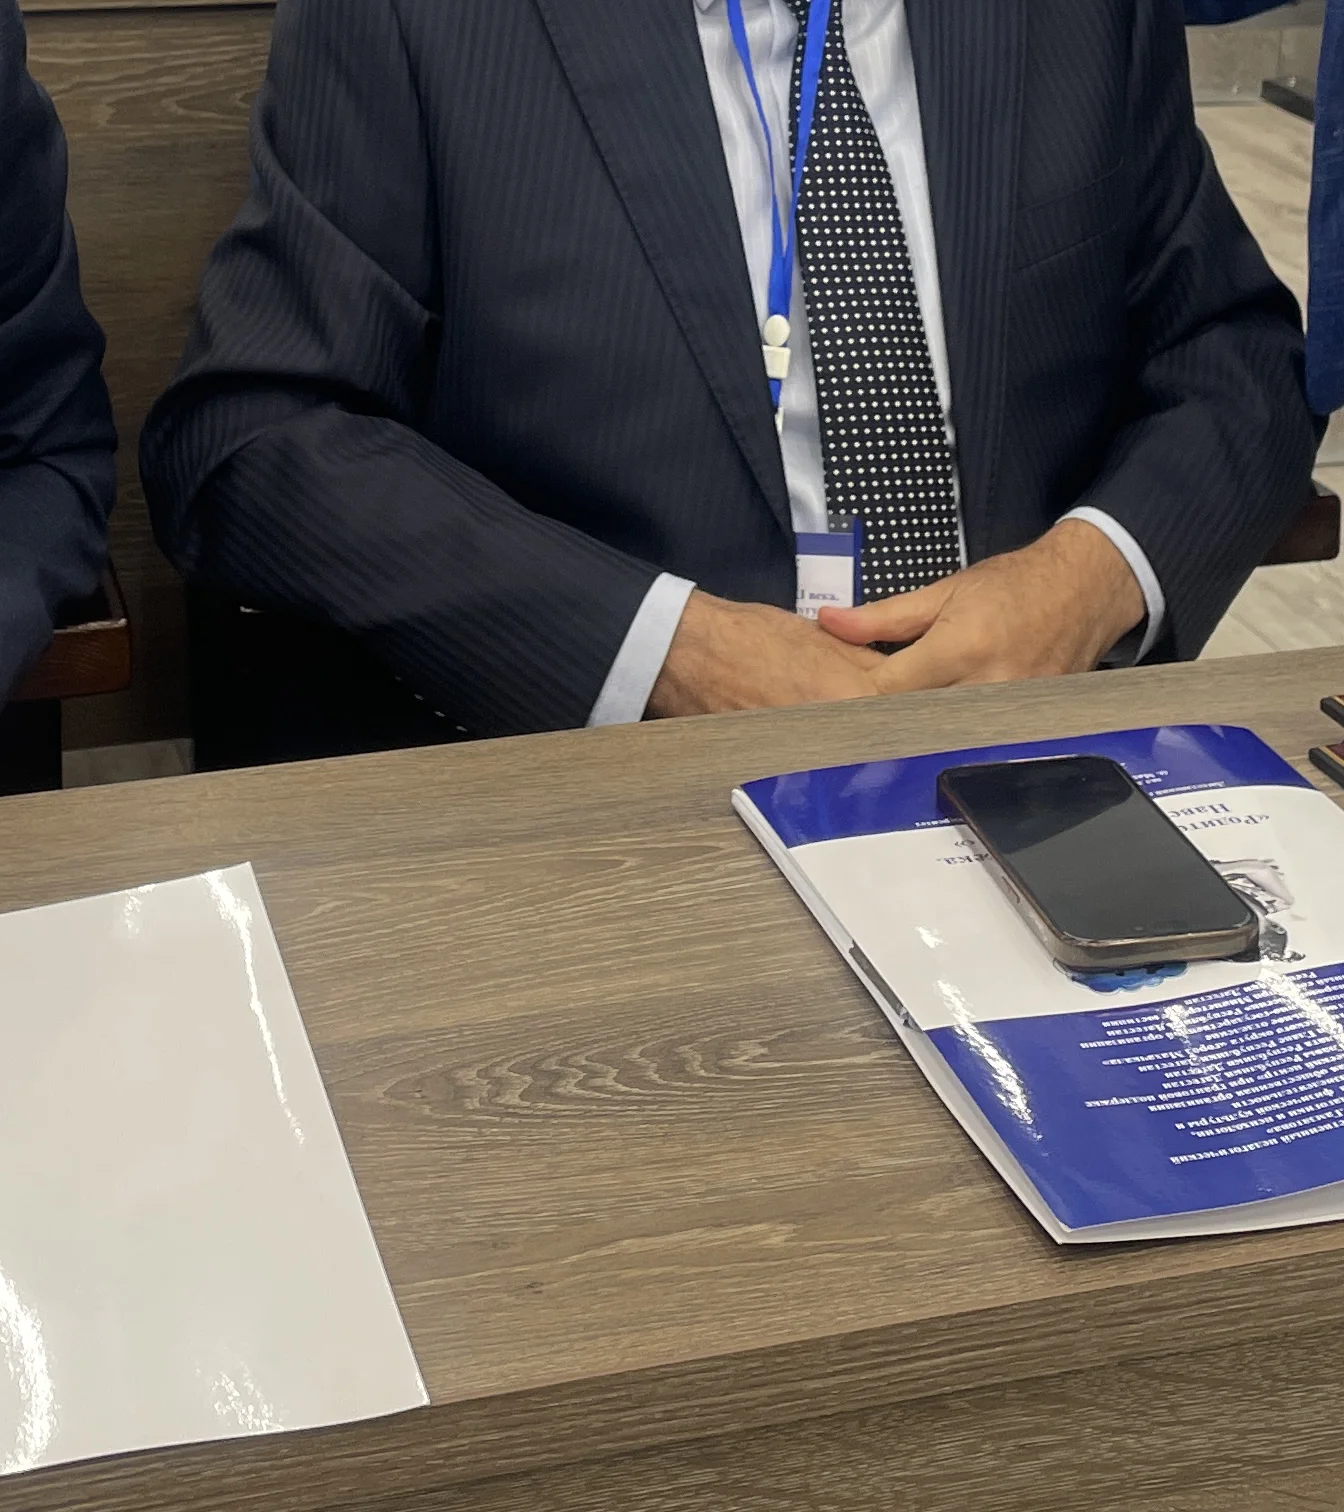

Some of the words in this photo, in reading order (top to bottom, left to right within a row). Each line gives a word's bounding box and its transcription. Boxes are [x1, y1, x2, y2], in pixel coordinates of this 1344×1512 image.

[1230, 1030, 1274, 1047] округа
[1279, 1029, 1317, 1047] Главе
[1226, 1043, 1304, 1069] Республики
[1165, 1062, 1225, 1081] Дагестан
[1224, 1054, 1303, 1081] Республики
[1257, 1064, 1304, 1082] центр»
[1158, 1081, 1227, 1102] грантовой
[1162, 1072, 1223, 1090] Дагестан
[1228, 1074, 1255, 1089] при
[1235, 1068, 1328, 1098] общественная
[1255, 1088, 1335, 1117] физической
[1188, 1108, 1254, 1129] культуры
[1190, 1115, 1274, 1140] психологии,
[1170, 1137, 1278, 1166] педагогический
